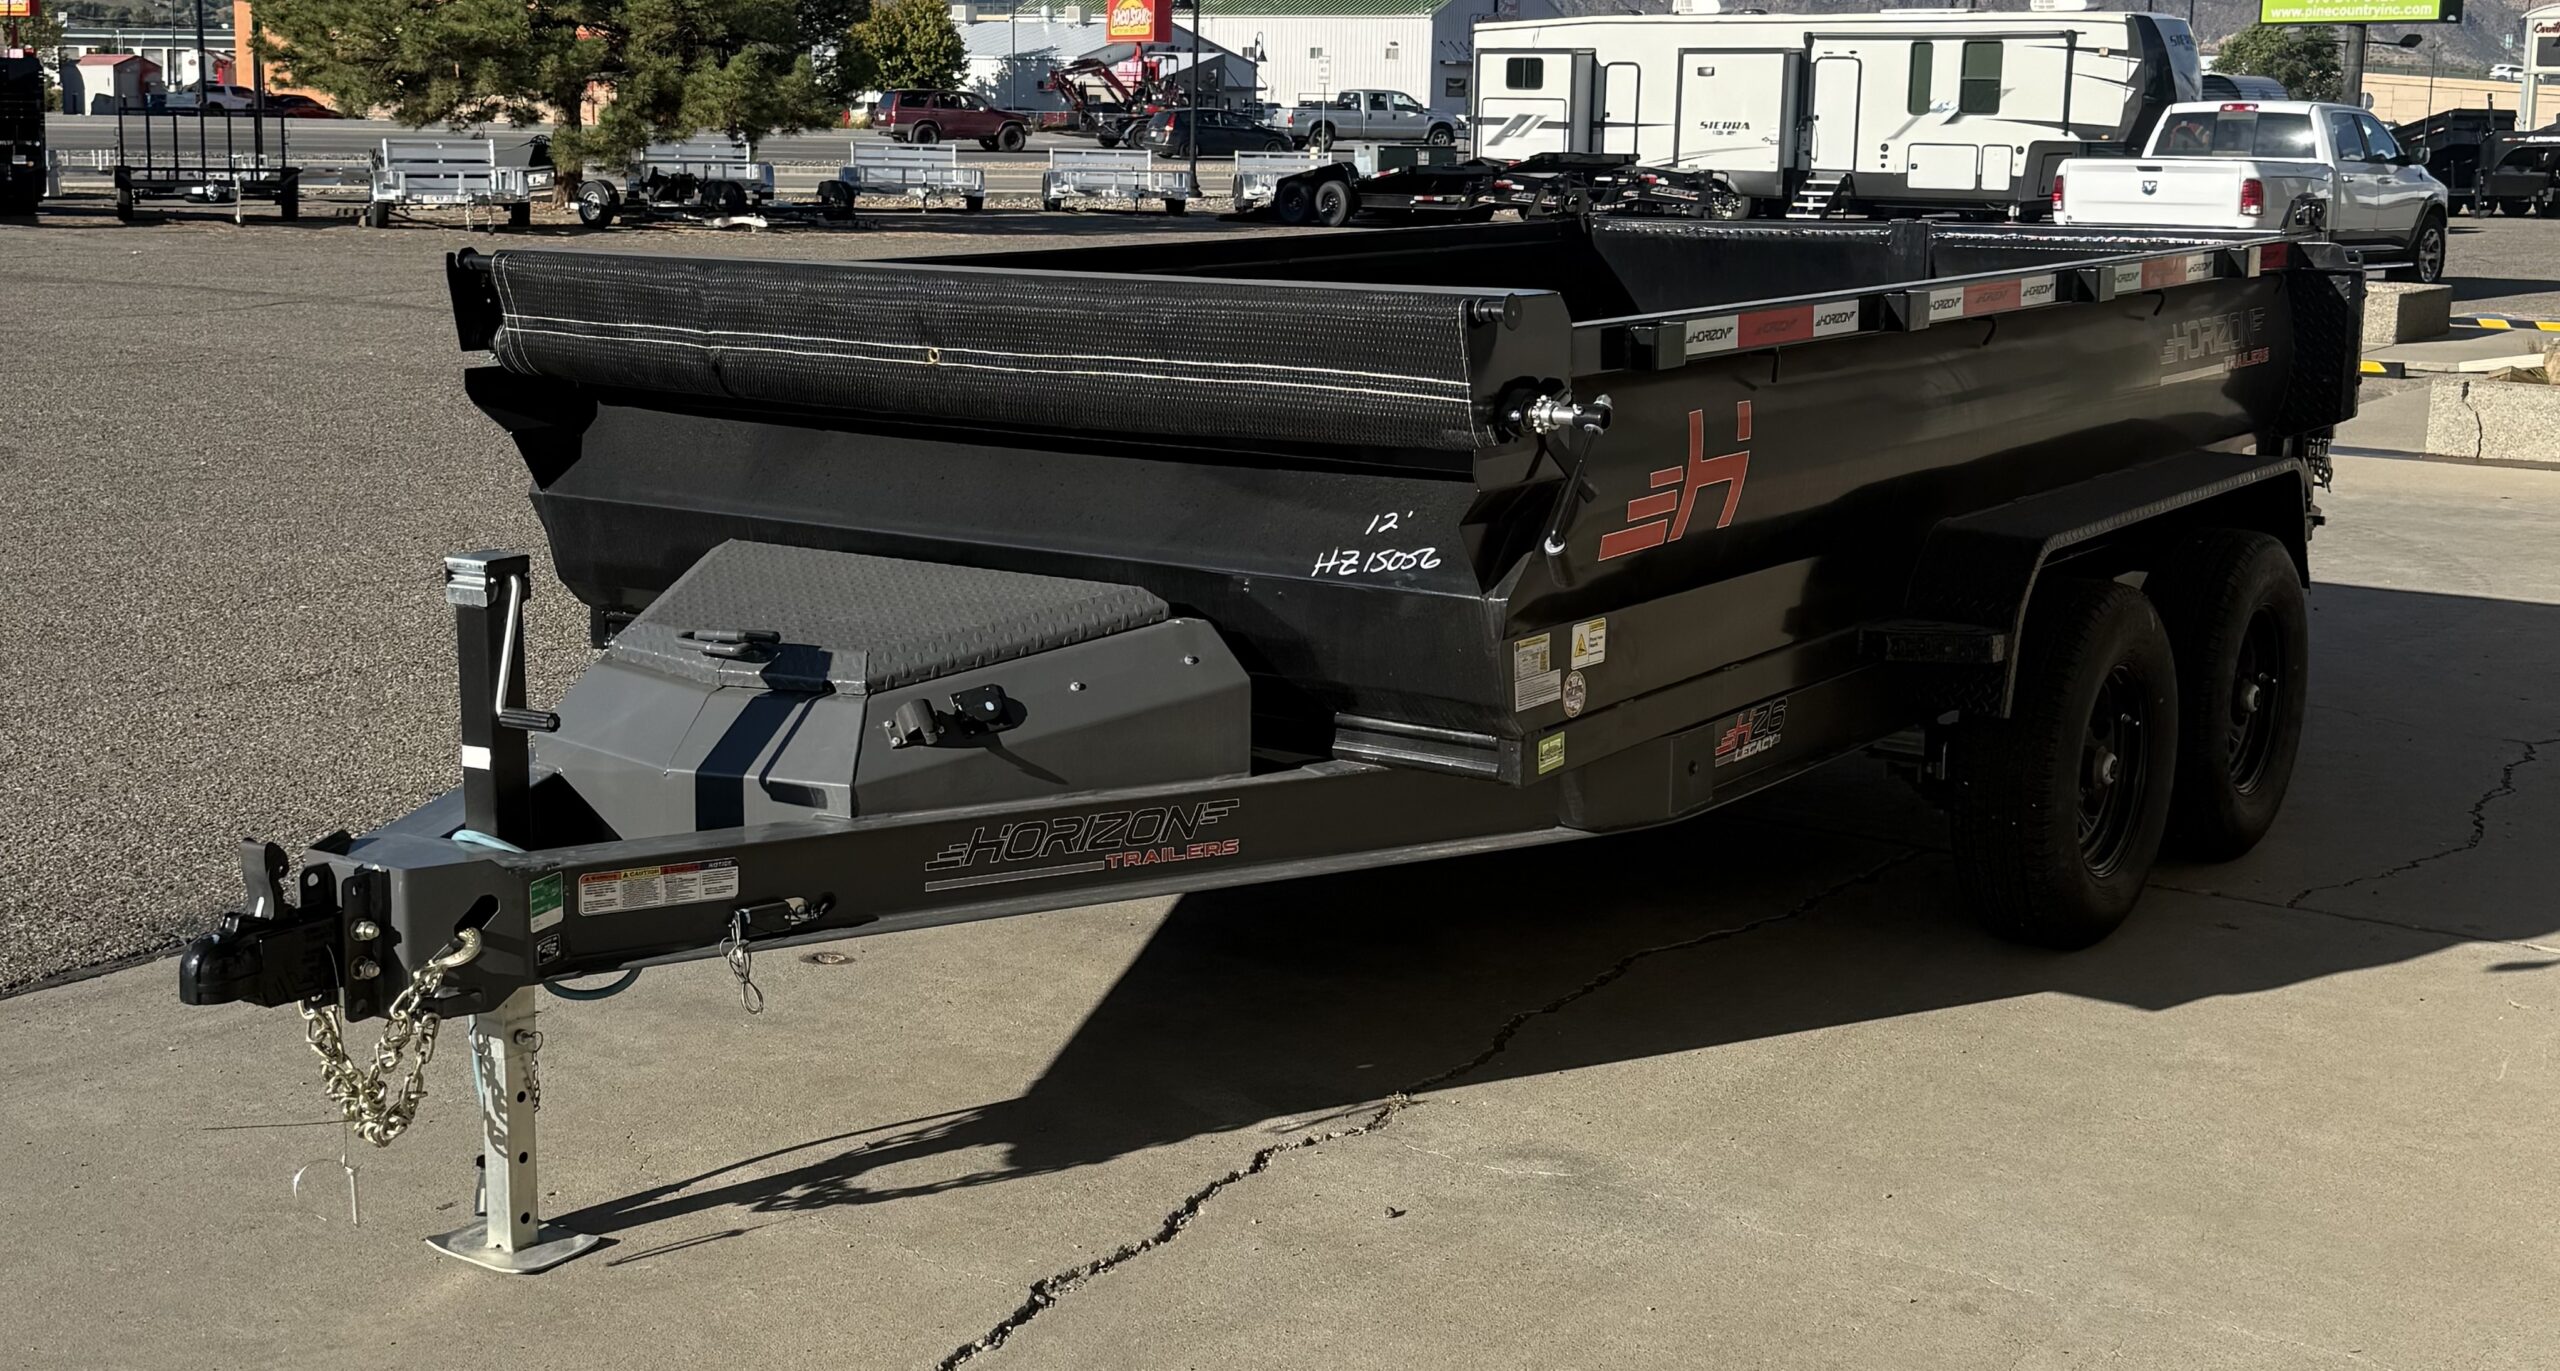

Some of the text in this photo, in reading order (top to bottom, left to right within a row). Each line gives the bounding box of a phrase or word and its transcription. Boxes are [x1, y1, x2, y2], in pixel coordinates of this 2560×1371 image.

[2271, 4, 2432, 18] www.pinecountryinc.com
[1700, 121, 1750, 130] SIERRA
[1819, 312, 1854, 326] HORIZON
[1690, 327, 1731, 343] HORIZON
[2223, 347, 2270, 371] TRAILERS
[1365, 510, 1413, 535] 12'
[1311, 547, 1441, 577] HZ15056
[1734, 734, 1778, 762] LEGACY
[950, 800, 1218, 867] HORIZON
[1105, 839, 1240, 869] TRAILERS
[629, 869, 660, 877] CAUTION
